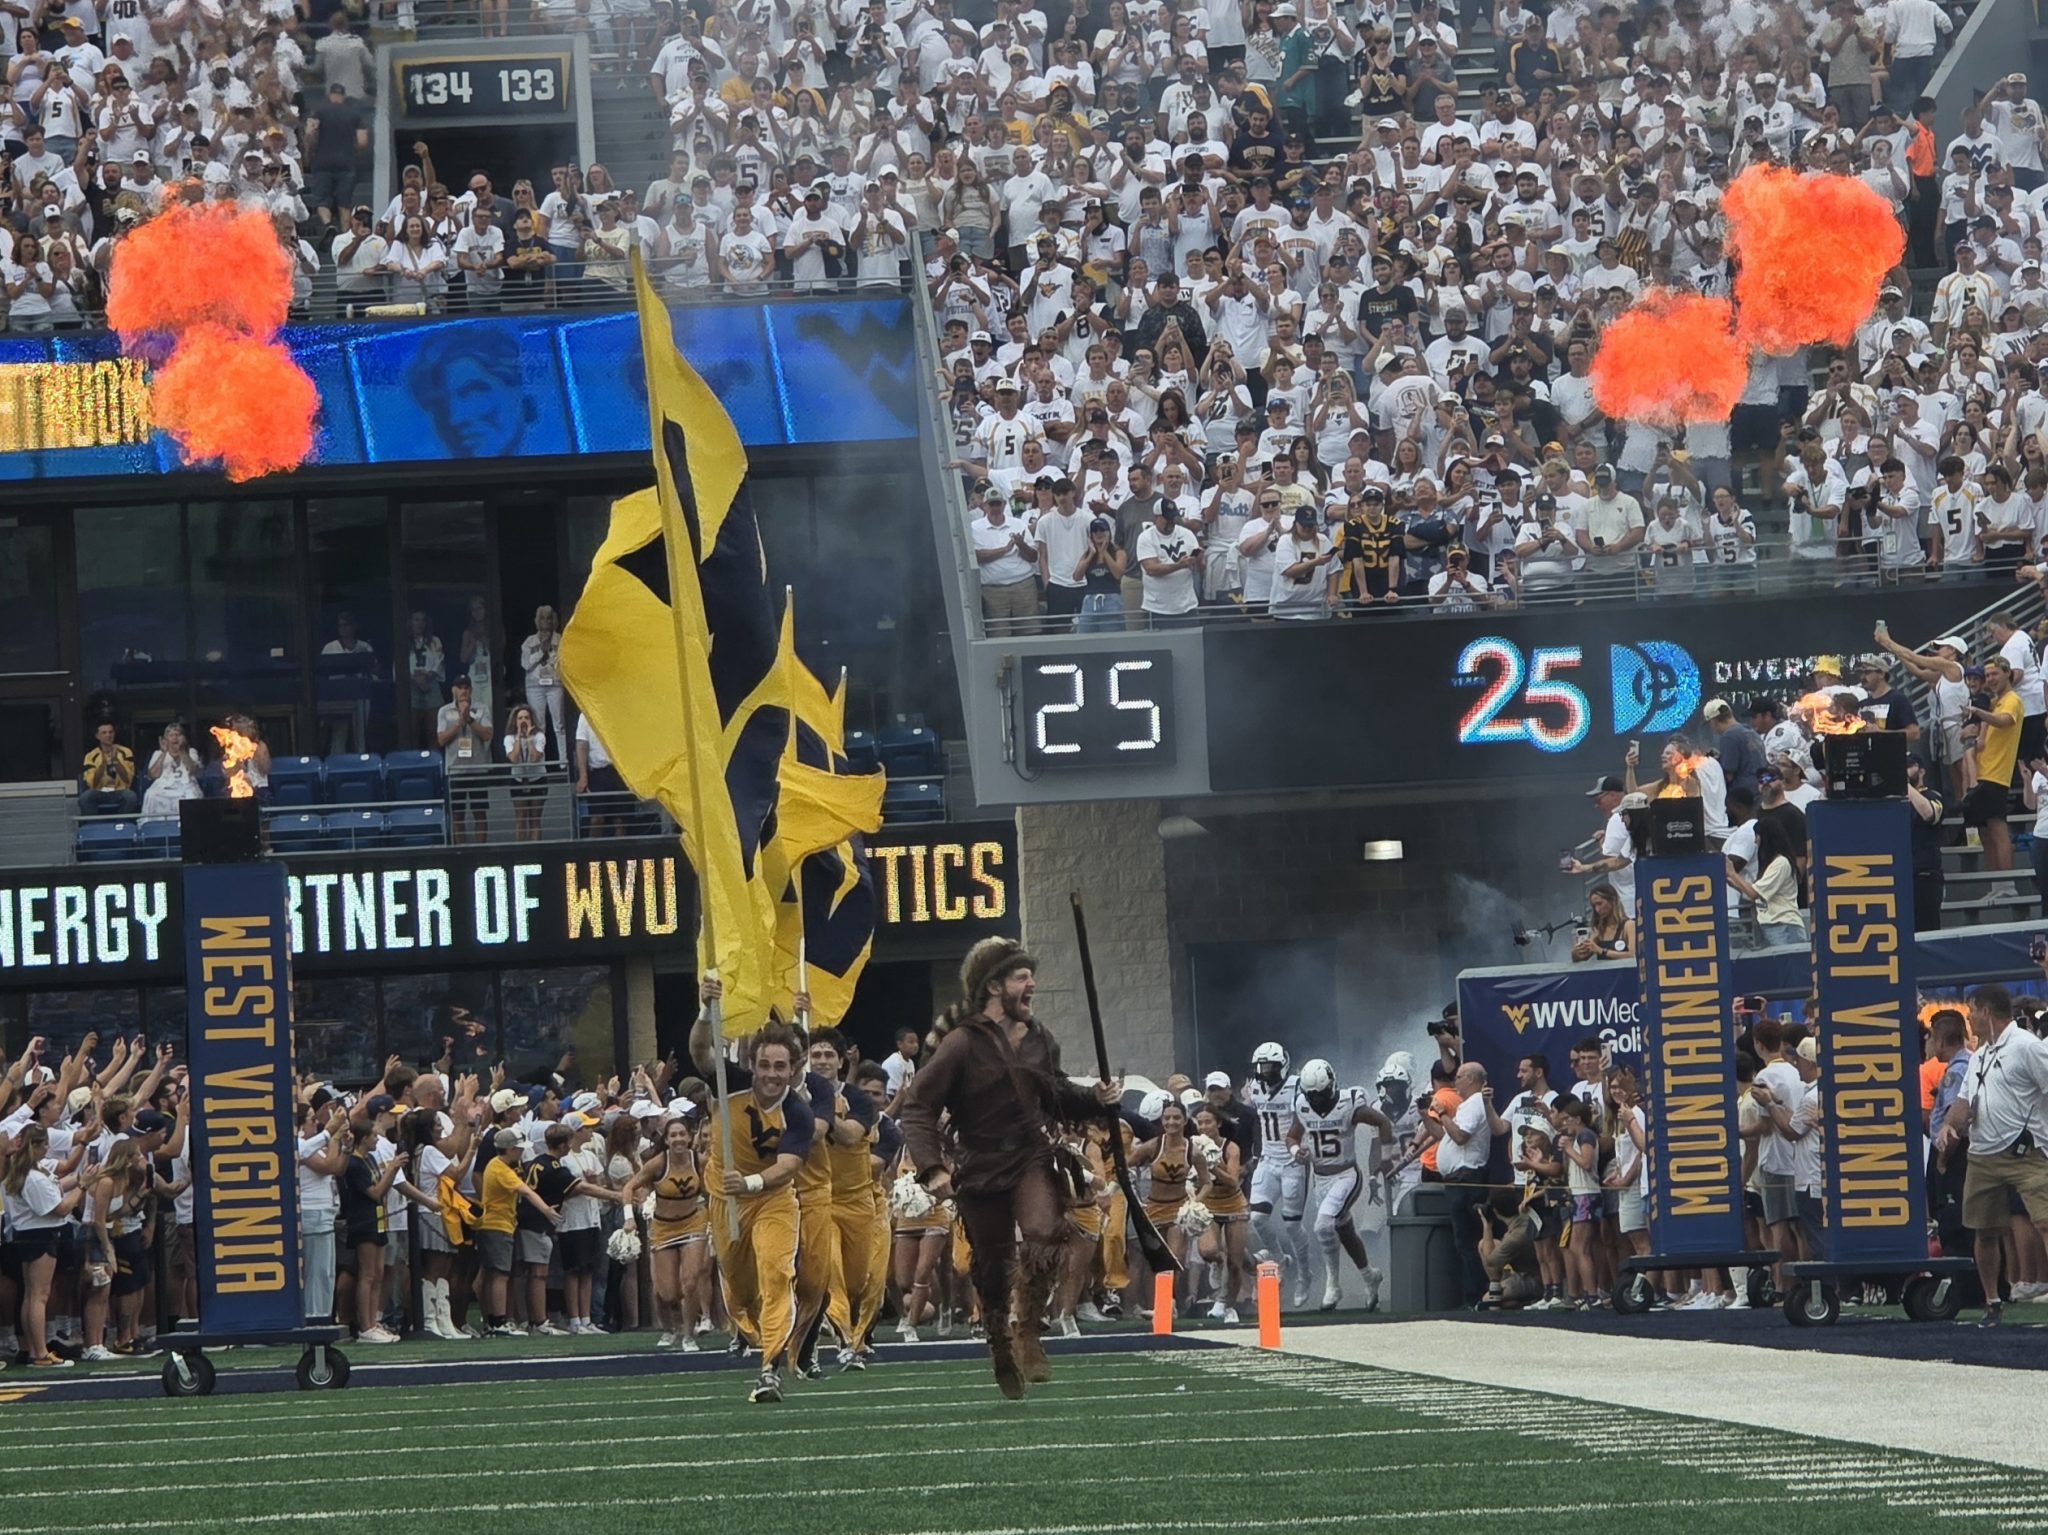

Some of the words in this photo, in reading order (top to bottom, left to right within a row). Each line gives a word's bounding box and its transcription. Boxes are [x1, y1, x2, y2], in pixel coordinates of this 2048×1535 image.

[51, 101, 63, 118] 5
[410, 71, 473, 105] 134
[498, 68, 555, 102] 133
[740, 163, 758, 188] 5
[1076, 318, 1091, 339] 8
[1004, 434, 1015, 456] 5
[1946, 508, 1962, 535] 5
[1035, 660, 1161, 754] 25
[1457, 635, 1592, 753] 25
[474, 864, 543, 944] OF
[565, 857, 679, 939] WVU
[866, 841, 1006, 923] TICS
[1825, 854, 1899, 984] WEST
[201, 915, 275, 1047] WEST
[1652, 874, 1731, 1216] MOUNTAINEERS
[1262, 1111, 1281, 1142] 11
[1309, 1128, 1342, 1158] 15
[1831, 1000, 1910, 1228] VIRGINIA
[203, 1063, 285, 1294] VIRGINIA
